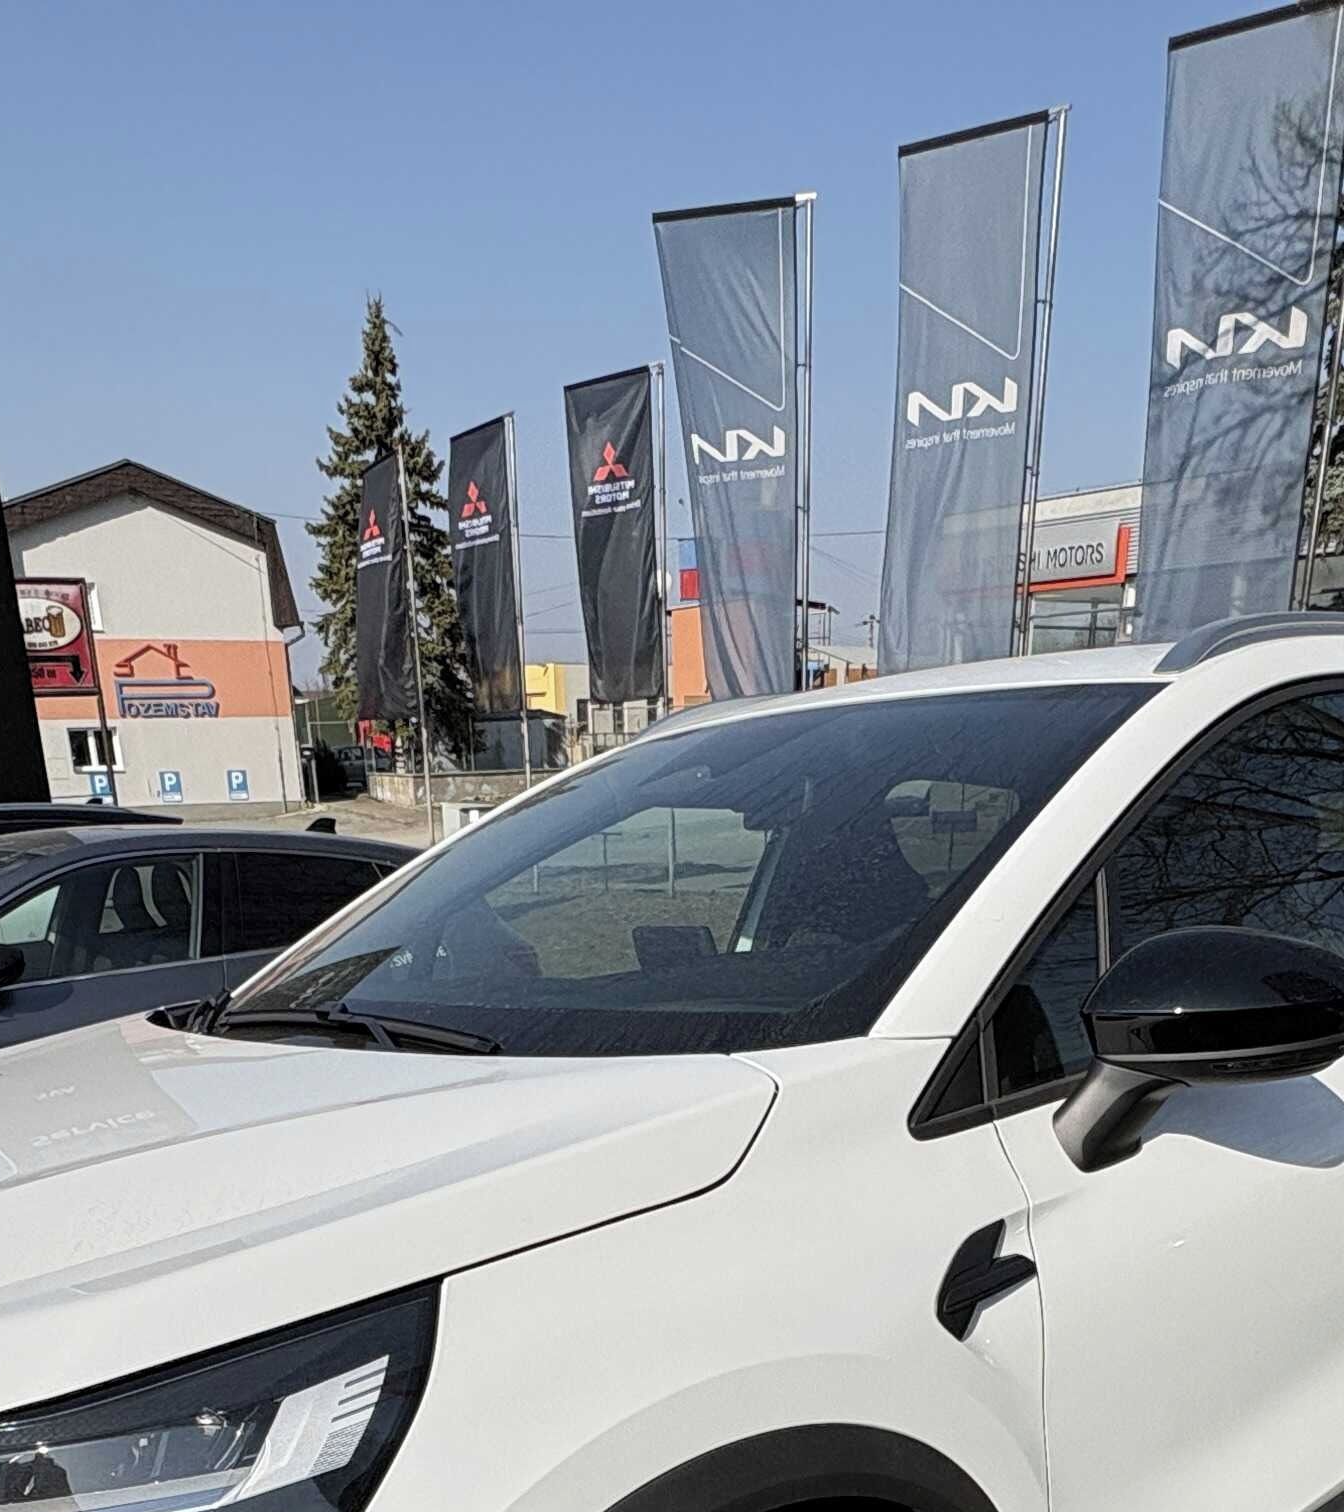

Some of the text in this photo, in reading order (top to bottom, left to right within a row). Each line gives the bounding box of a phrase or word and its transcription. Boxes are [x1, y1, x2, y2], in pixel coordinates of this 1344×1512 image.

[1047, 542, 1104, 568] MOTORS
[94, 775, 107, 794] P
[164, 773, 177, 791] P
[232, 772, 244, 790] P
